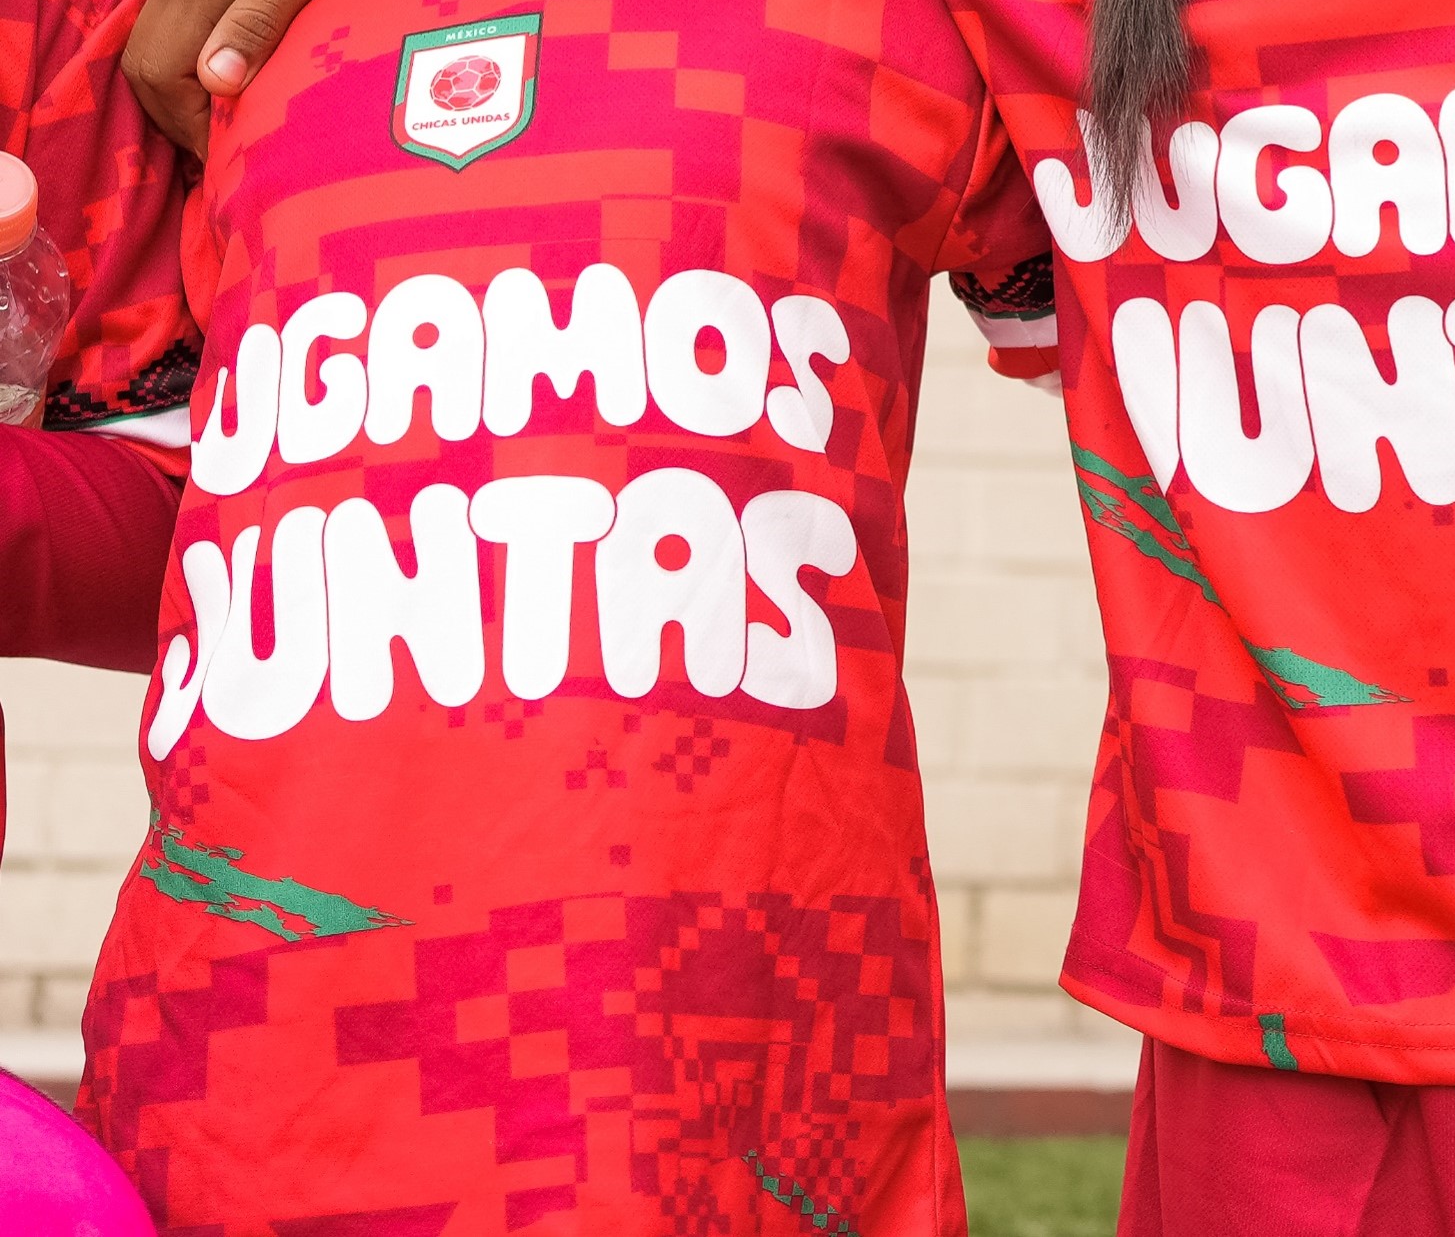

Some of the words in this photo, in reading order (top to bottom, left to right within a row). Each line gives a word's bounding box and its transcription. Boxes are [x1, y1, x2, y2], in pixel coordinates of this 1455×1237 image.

[445, 25, 498, 42] MÉXICO
[412, 118, 457, 131] CHICAS
[462, 113, 510, 125] UNIDAS
[148, 467, 857, 762] JUNTAS
